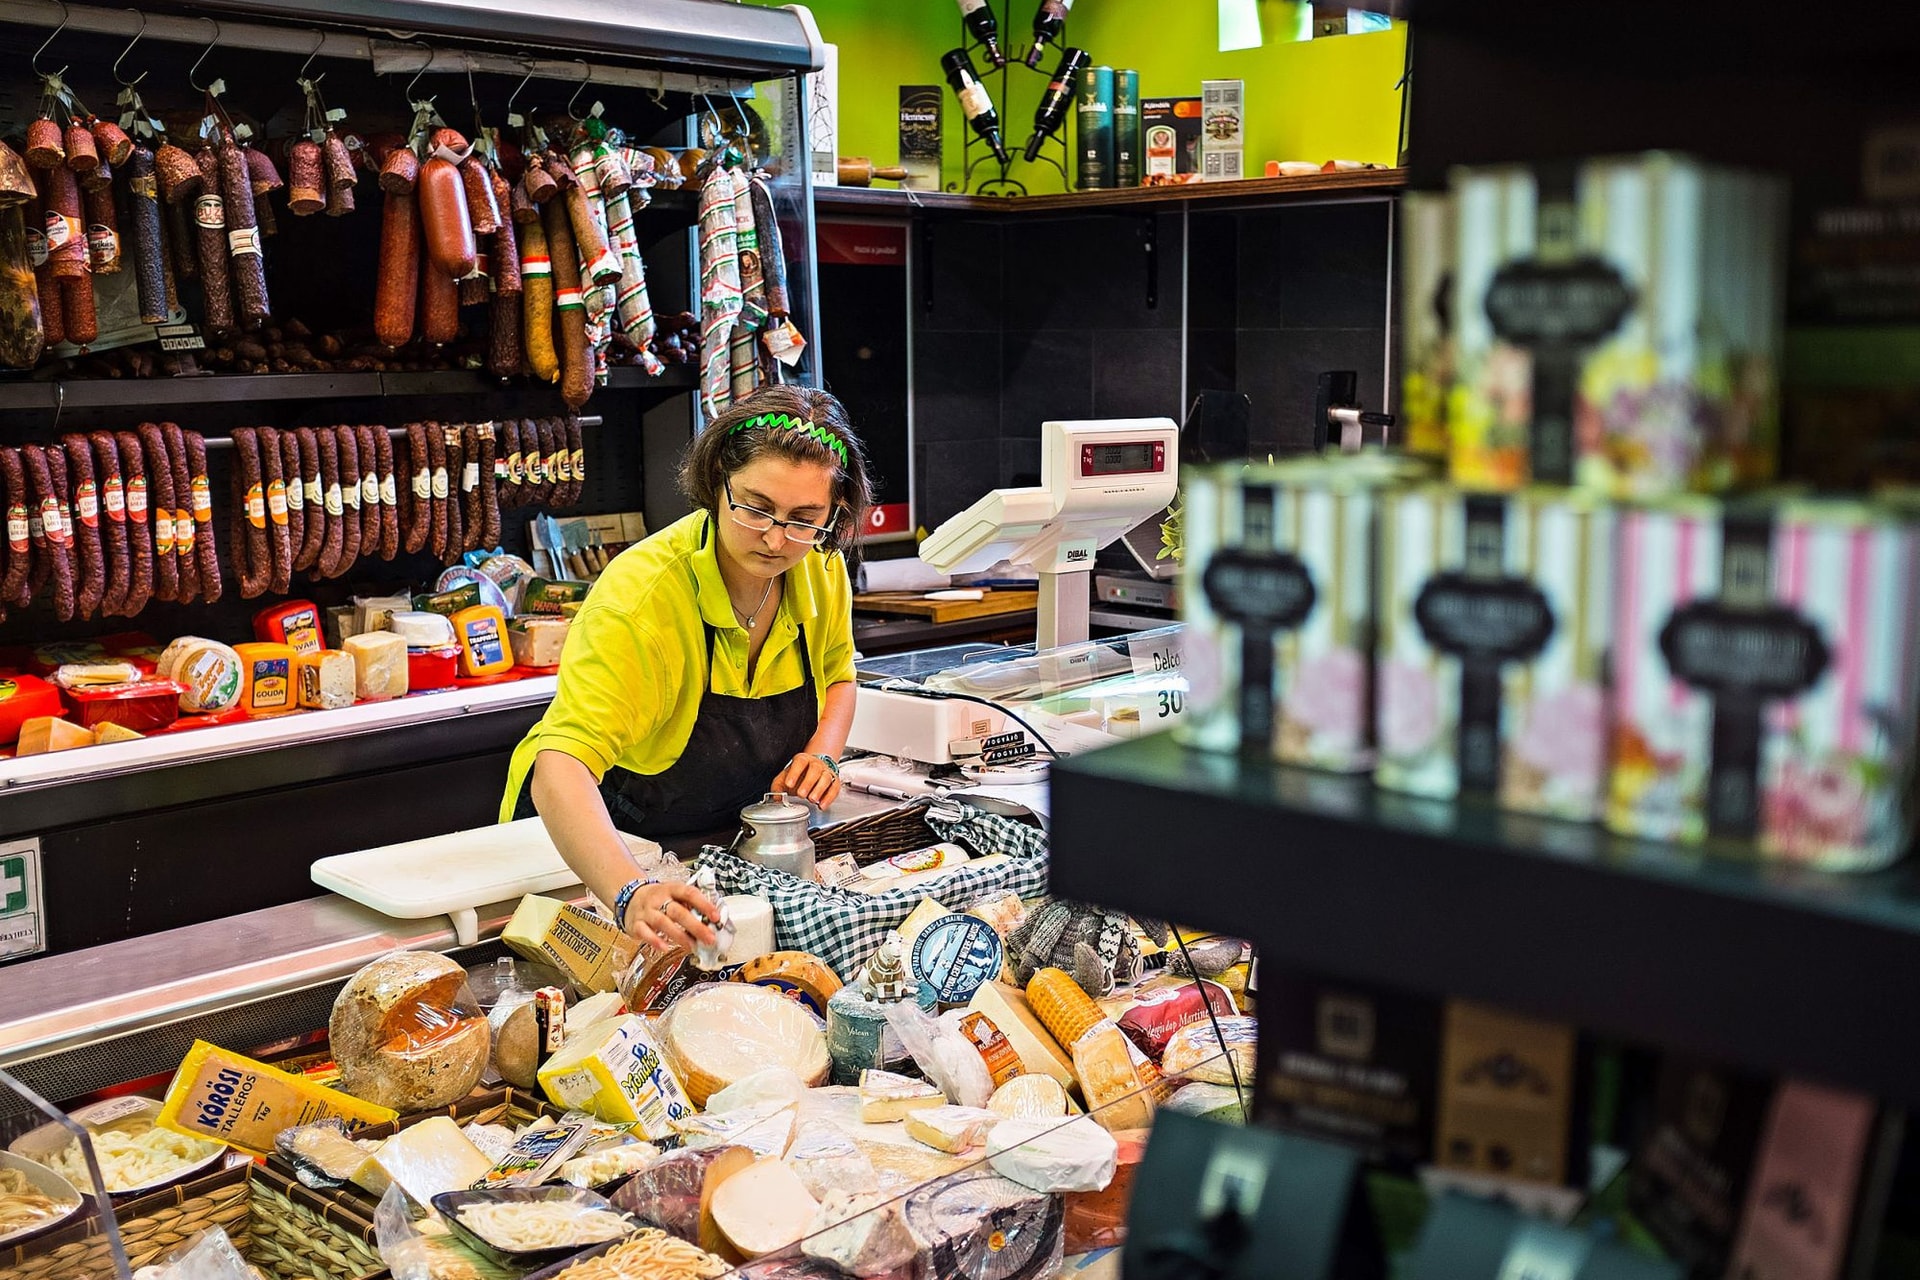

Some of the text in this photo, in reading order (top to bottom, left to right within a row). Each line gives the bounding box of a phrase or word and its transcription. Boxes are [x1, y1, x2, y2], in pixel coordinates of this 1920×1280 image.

[901, 112, 936, 123] Hennessy
[1087, 150, 1096, 158] 12
[1067, 549, 1088, 559] DIBAL
[469, 633, 499, 645] TRAPPISTA
[256, 689, 284, 699] GOUDA
[551, 924, 598, 964] LE GRUYÈRE
[220, 1075, 257, 1133] TALLÉROS
